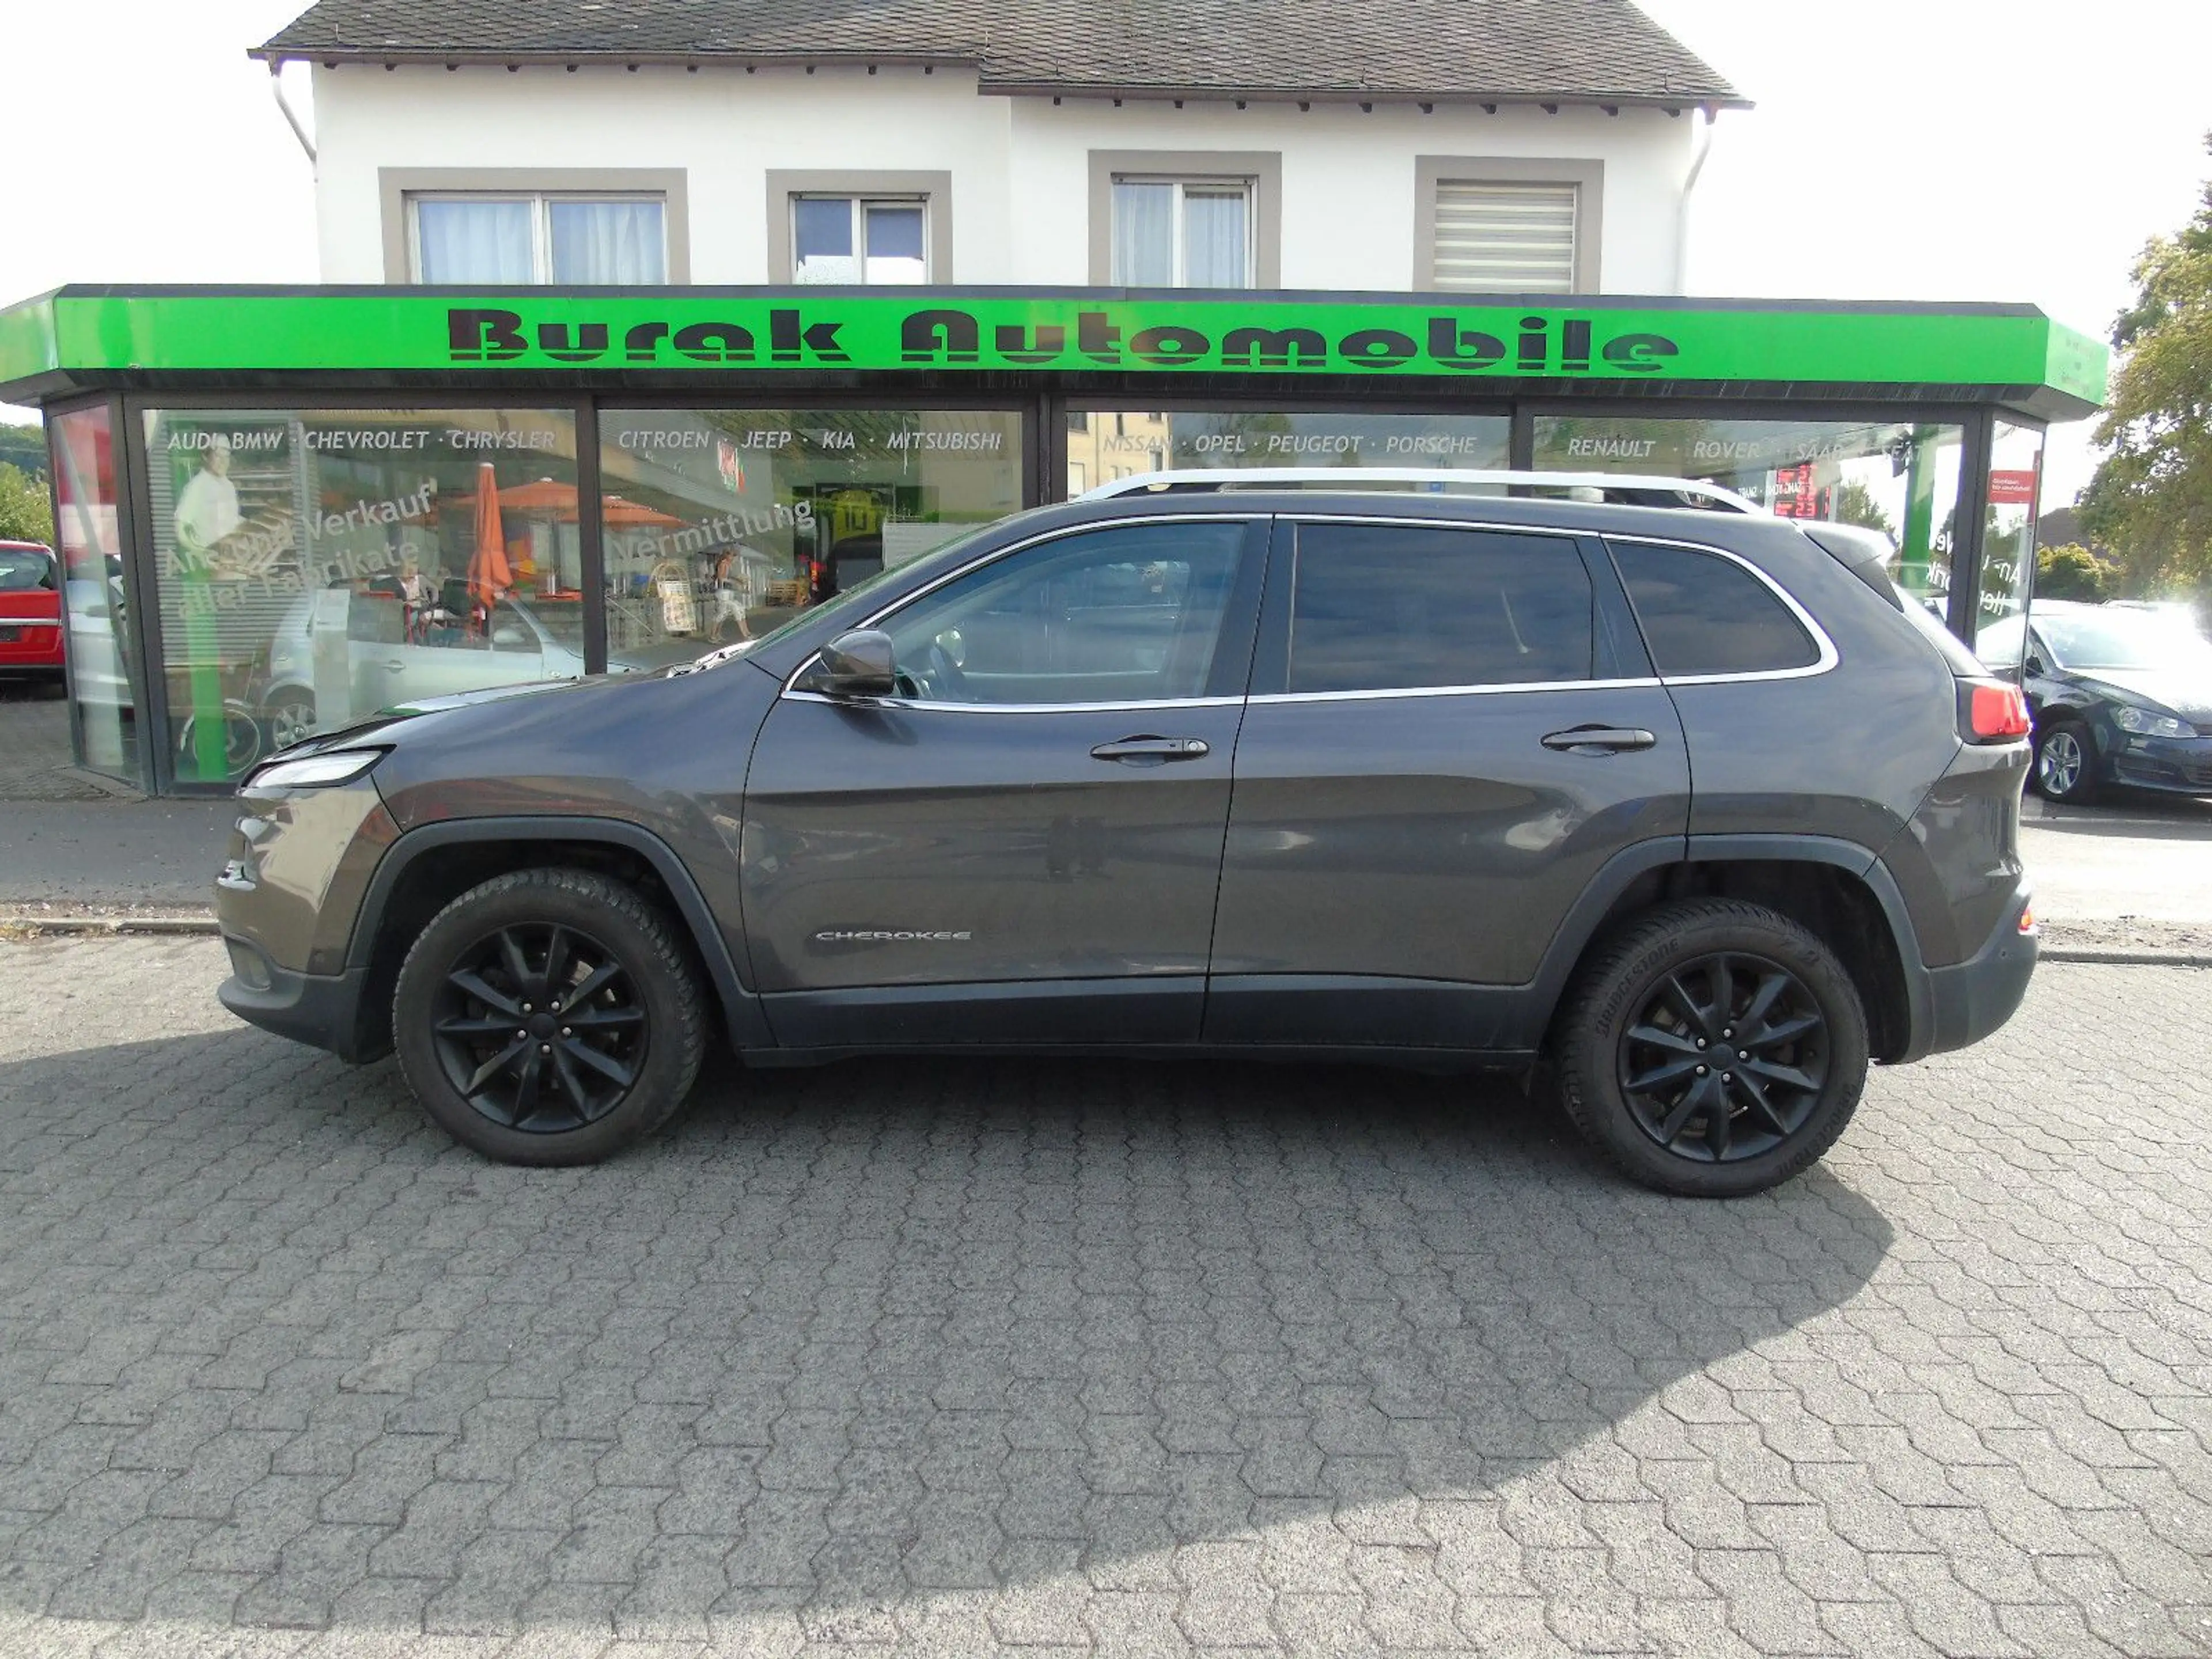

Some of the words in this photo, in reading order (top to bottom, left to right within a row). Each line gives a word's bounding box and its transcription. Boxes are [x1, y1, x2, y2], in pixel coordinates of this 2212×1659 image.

[448, 309, 852, 362] Burak
[901, 309, 1680, 372] Automobile
[167, 432, 215, 450] AUDI
[232, 431, 283, 449] BMW
[304, 430, 430, 449] CHEVROLET
[450, 430, 555, 449] CHRYSLER
[618, 430, 710, 449] CITROEN
[741, 430, 792, 449] JEEP
[822, 431, 856, 449] KIA
[887, 431, 1002, 450] MITSUBISHI
[1104, 435, 1172, 453] NISSAN
[1195, 435, 1246, 453] OPEL
[1267, 435, 1365, 453] PEUGEOT
[1386, 435, 1478, 454] PORSCHE
[1567, 438, 1657, 457] RENAULT
[1693, 441, 1760, 459] ROVER
[300, 483, 432, 540] Verkauf
[612, 499, 817, 560] Vermittlung
[260, 541, 420, 597] Fabrikate
[816, 931, 972, 941] CHEROKEE
